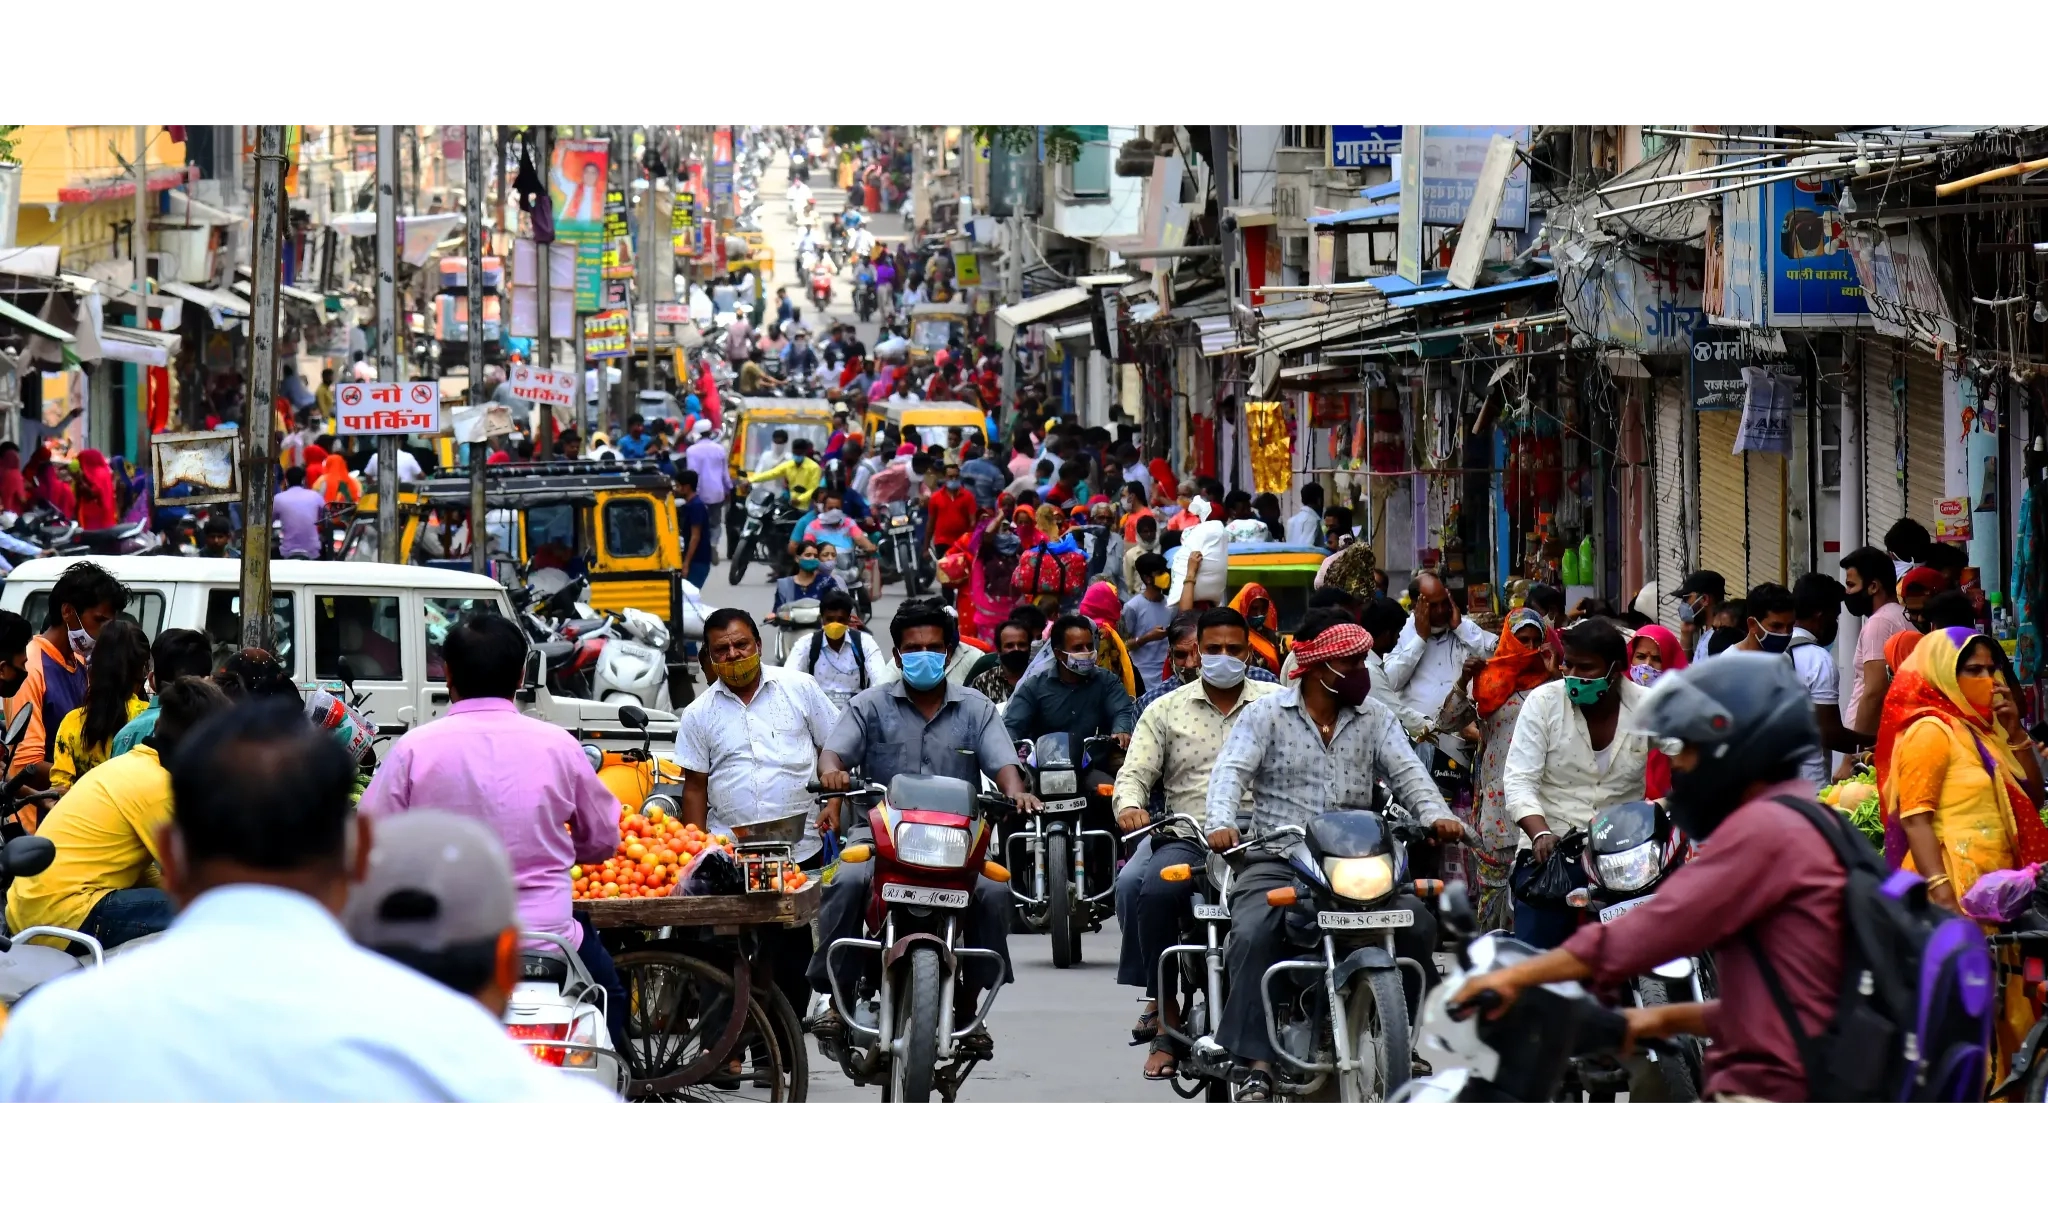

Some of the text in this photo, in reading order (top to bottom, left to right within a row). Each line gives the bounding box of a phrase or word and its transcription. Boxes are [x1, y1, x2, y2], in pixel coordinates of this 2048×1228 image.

[1786, 267, 1813, 280] पाली
[370, 384, 404, 403] नो
[513, 386, 570, 404] पार्किंग
[343, 409, 433, 430] पार्किंग
